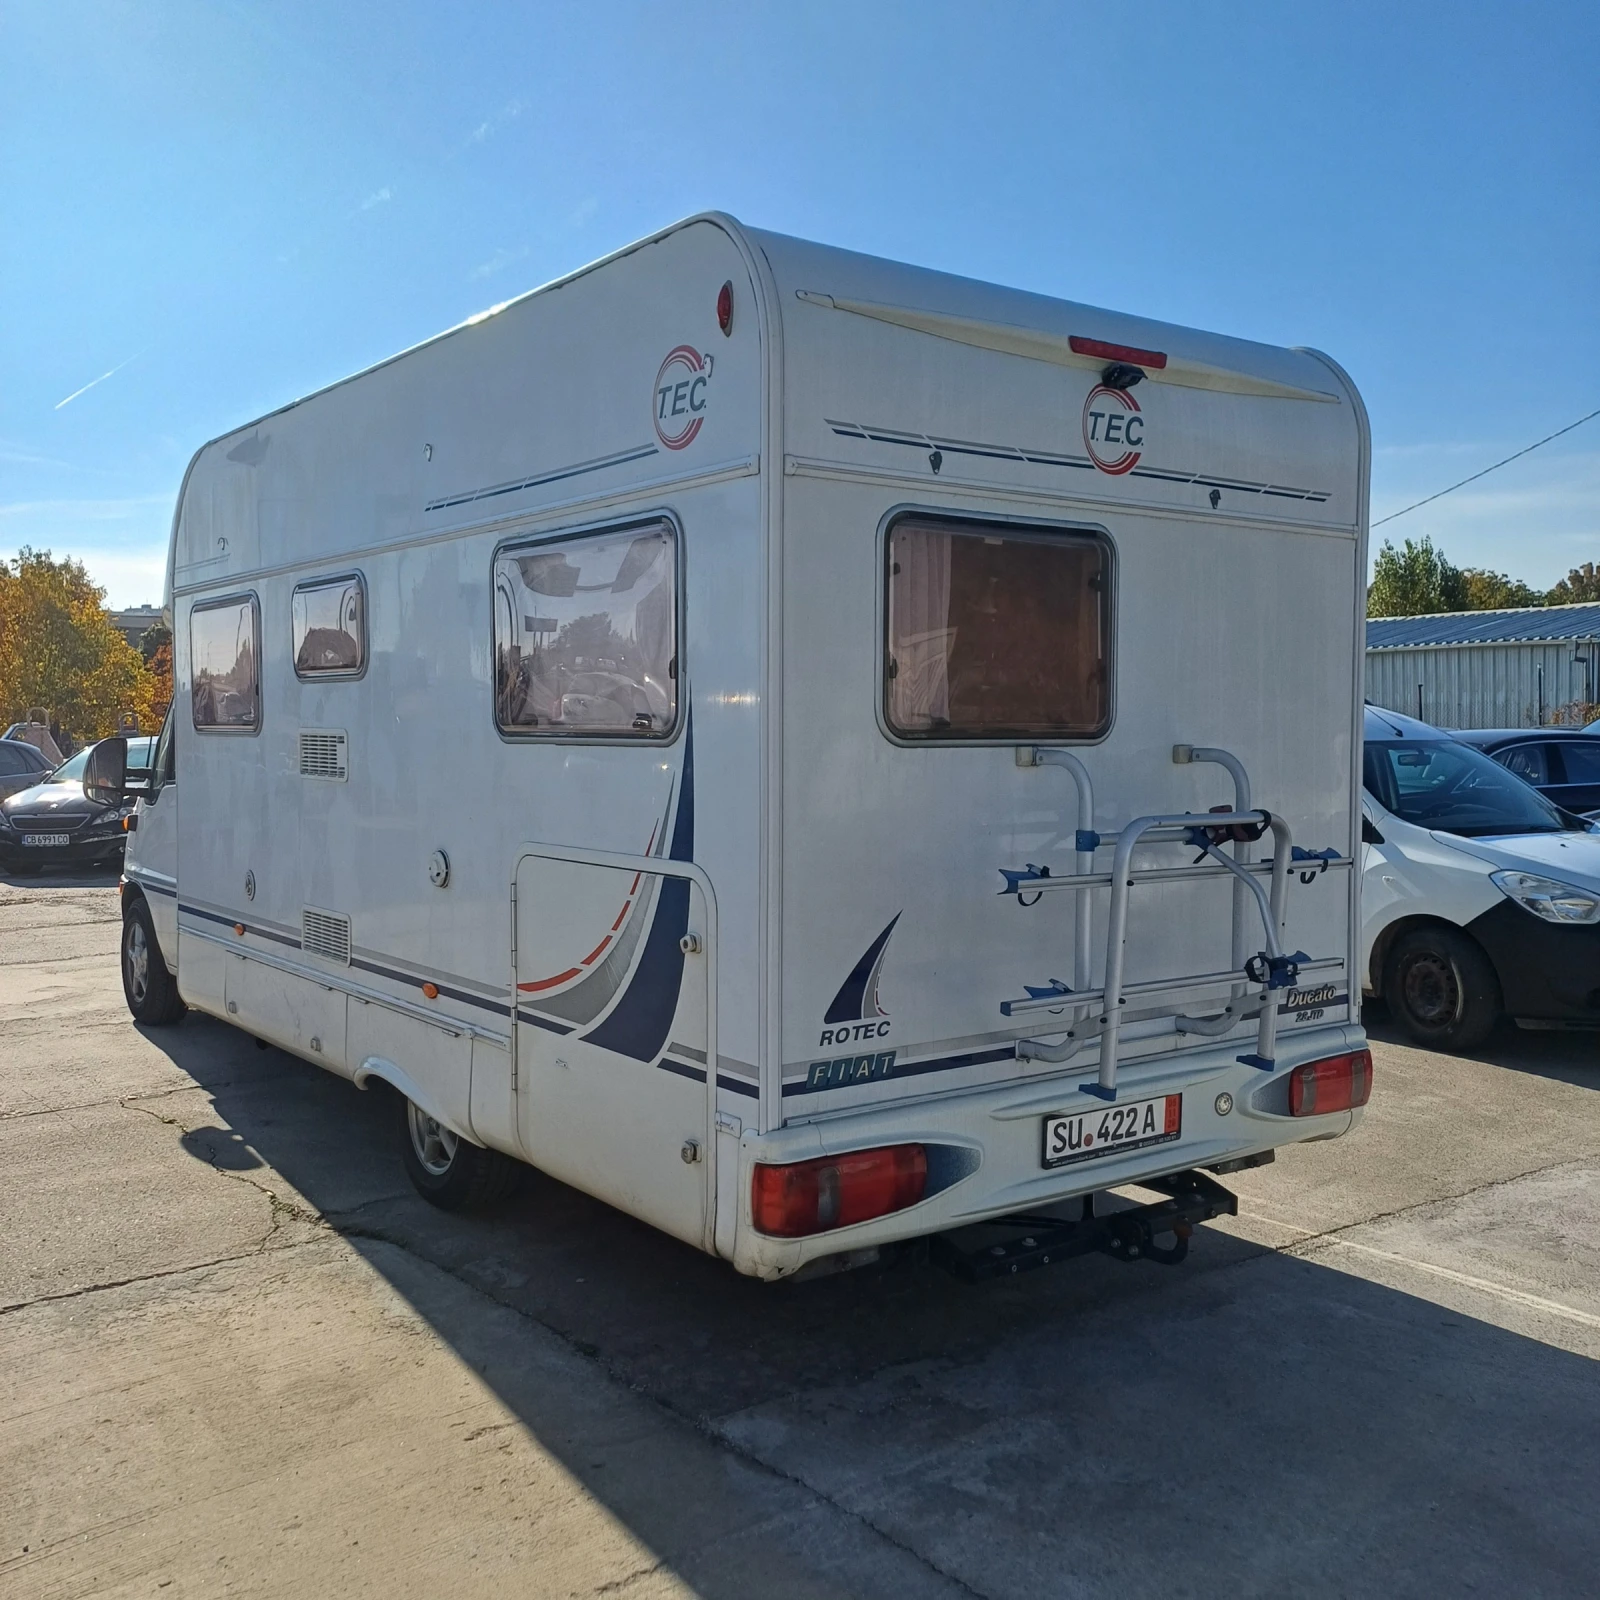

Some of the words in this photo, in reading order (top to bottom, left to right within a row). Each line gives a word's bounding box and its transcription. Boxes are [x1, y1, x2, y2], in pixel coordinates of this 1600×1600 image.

[1287, 983, 1337, 1008] Ducato
[819, 1020, 891, 1047] ROTEC
[811, 1054, 893, 1085] FIAT
